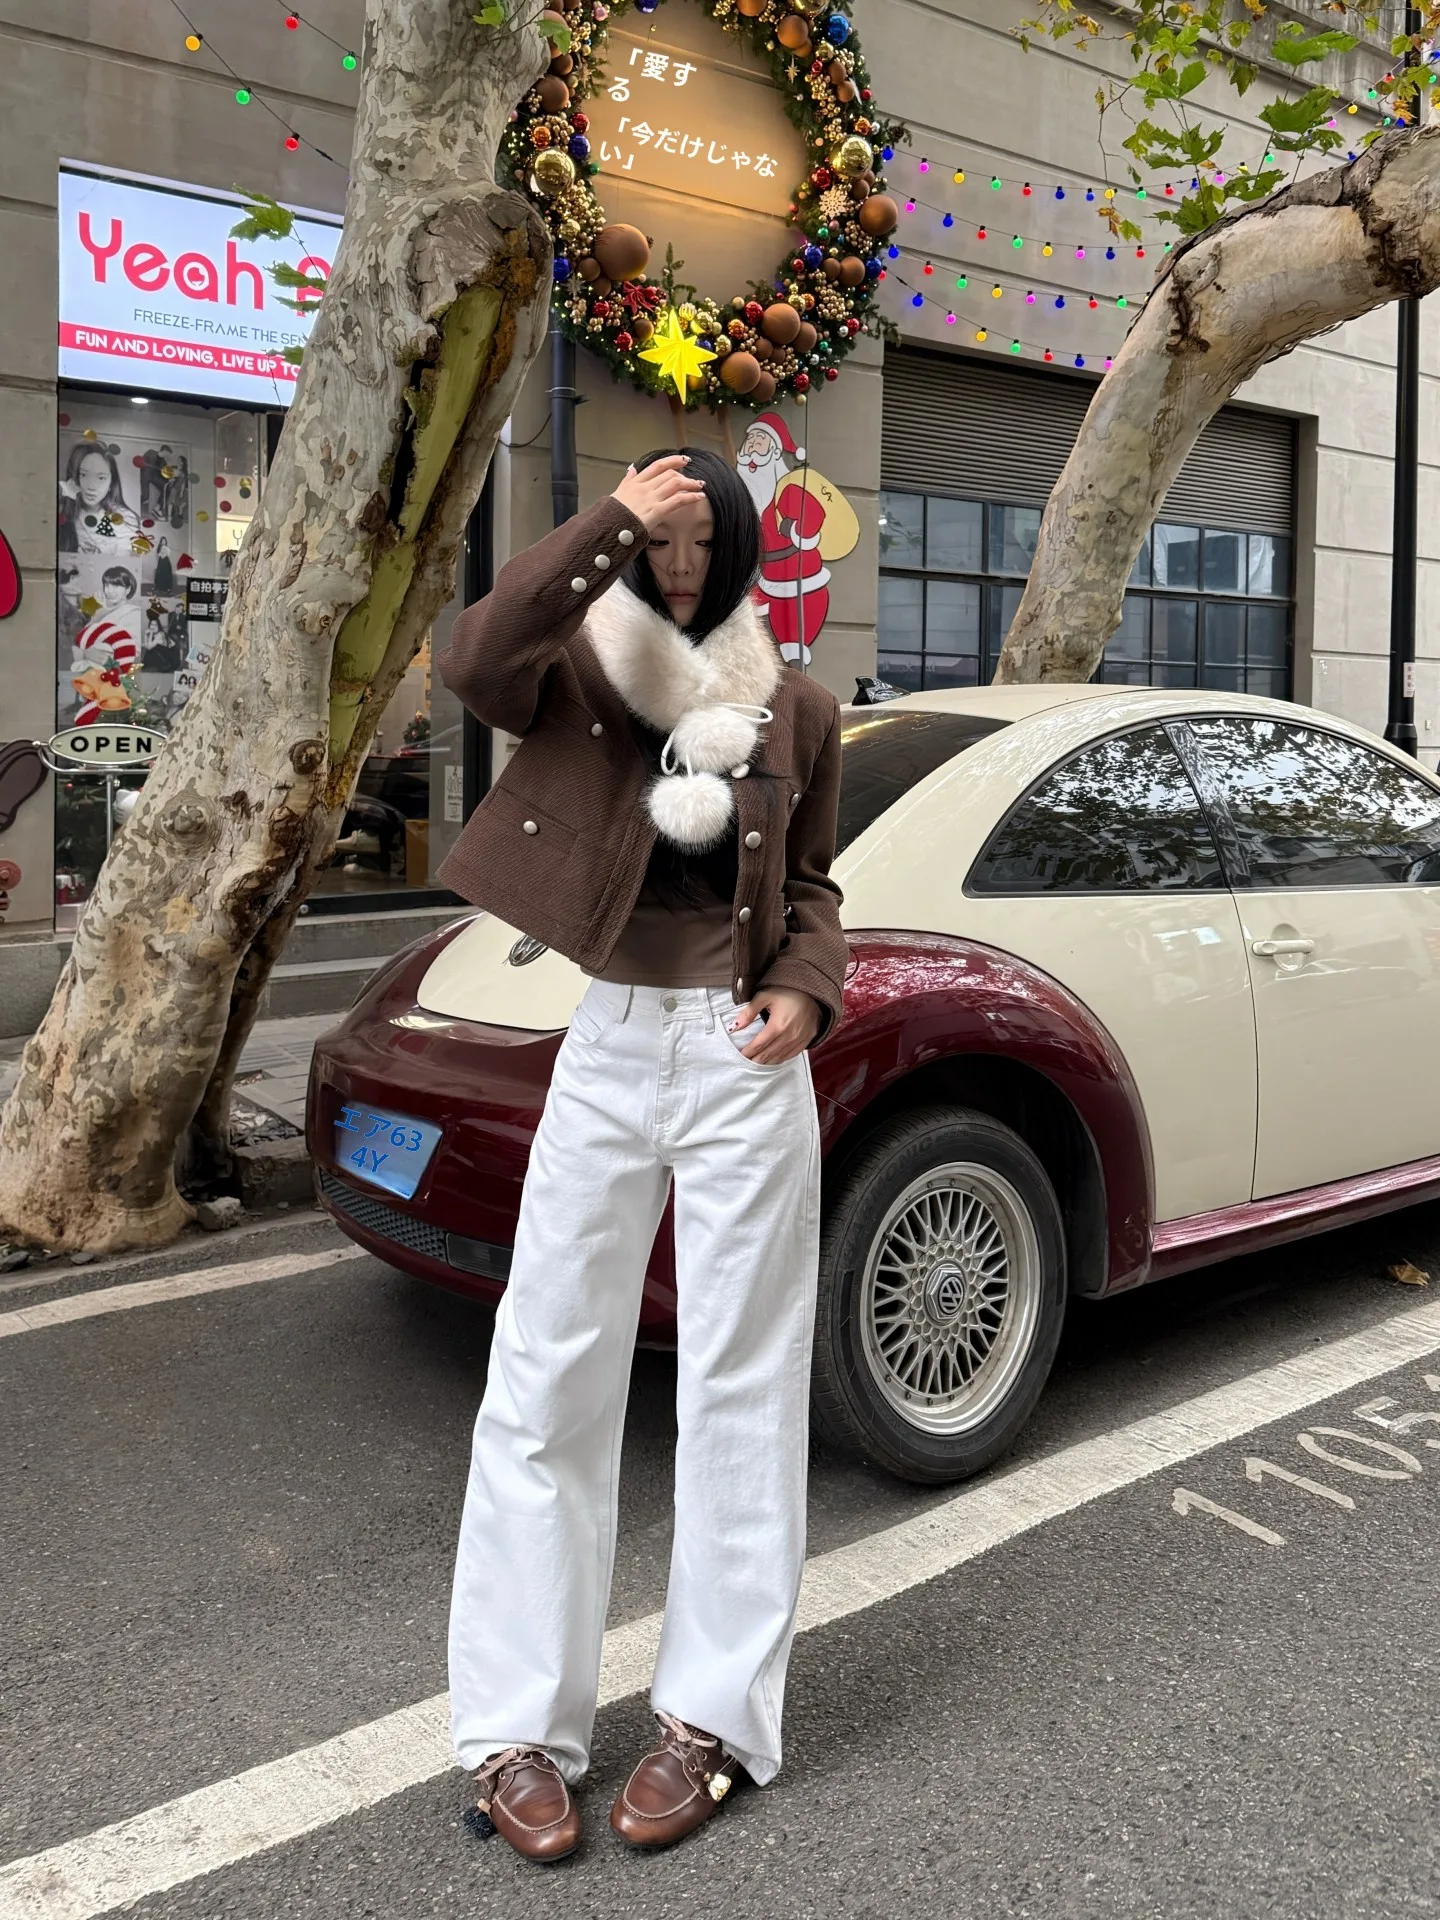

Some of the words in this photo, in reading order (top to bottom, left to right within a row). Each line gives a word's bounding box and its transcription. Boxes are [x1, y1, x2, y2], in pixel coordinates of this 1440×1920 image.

[629, 47, 697, 87] 「愛す
[607, 76, 630, 102] る
[600, 141, 635, 171] い」
[618, 116, 778, 177] 「今だけじゃな
[78, 211, 264, 310] Yeah
[133, 308, 248, 338] FREEZE-FRAME
[251, 327, 278, 343] THE
[75, 330, 108, 349] FUN
[111, 337, 149, 355] AND
[152, 342, 219, 368] LOVING,
[222, 353, 254, 371] LIVE
[257, 359, 277, 373] UP
[70, 736, 152, 753] OPEN
[333, 1106, 423, 1152] エア63
[350, 1146, 389, 1173] 4Y
